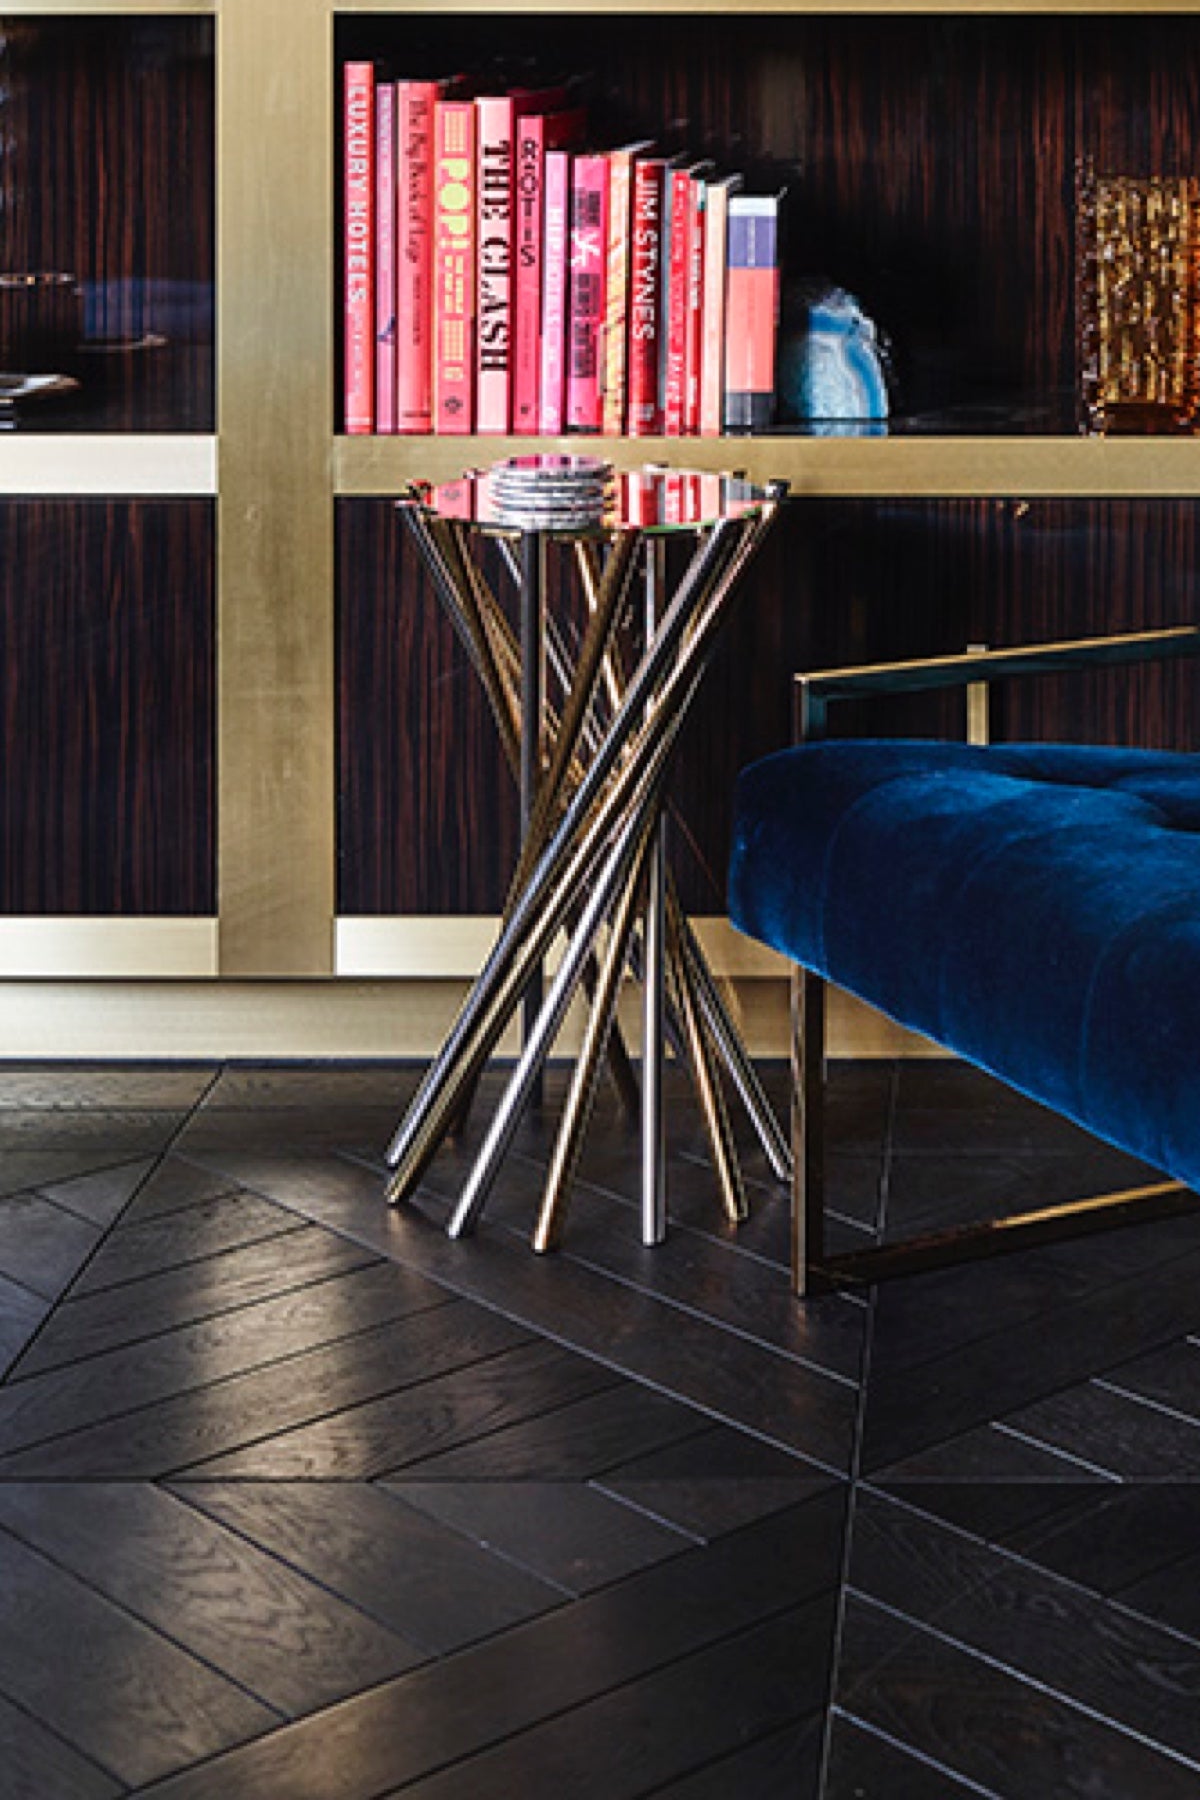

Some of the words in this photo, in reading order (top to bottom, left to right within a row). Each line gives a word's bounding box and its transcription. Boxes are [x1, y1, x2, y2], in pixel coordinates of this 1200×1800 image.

[347, 85, 367, 192] LUXURY
[482, 140, 509, 223] THE
[439, 157, 471, 250] POP!
[636, 174, 657, 221] JIM
[347, 201, 367, 304] HOTELS
[632, 229, 655, 340] STYNES
[480, 236, 508, 373] CLASH
